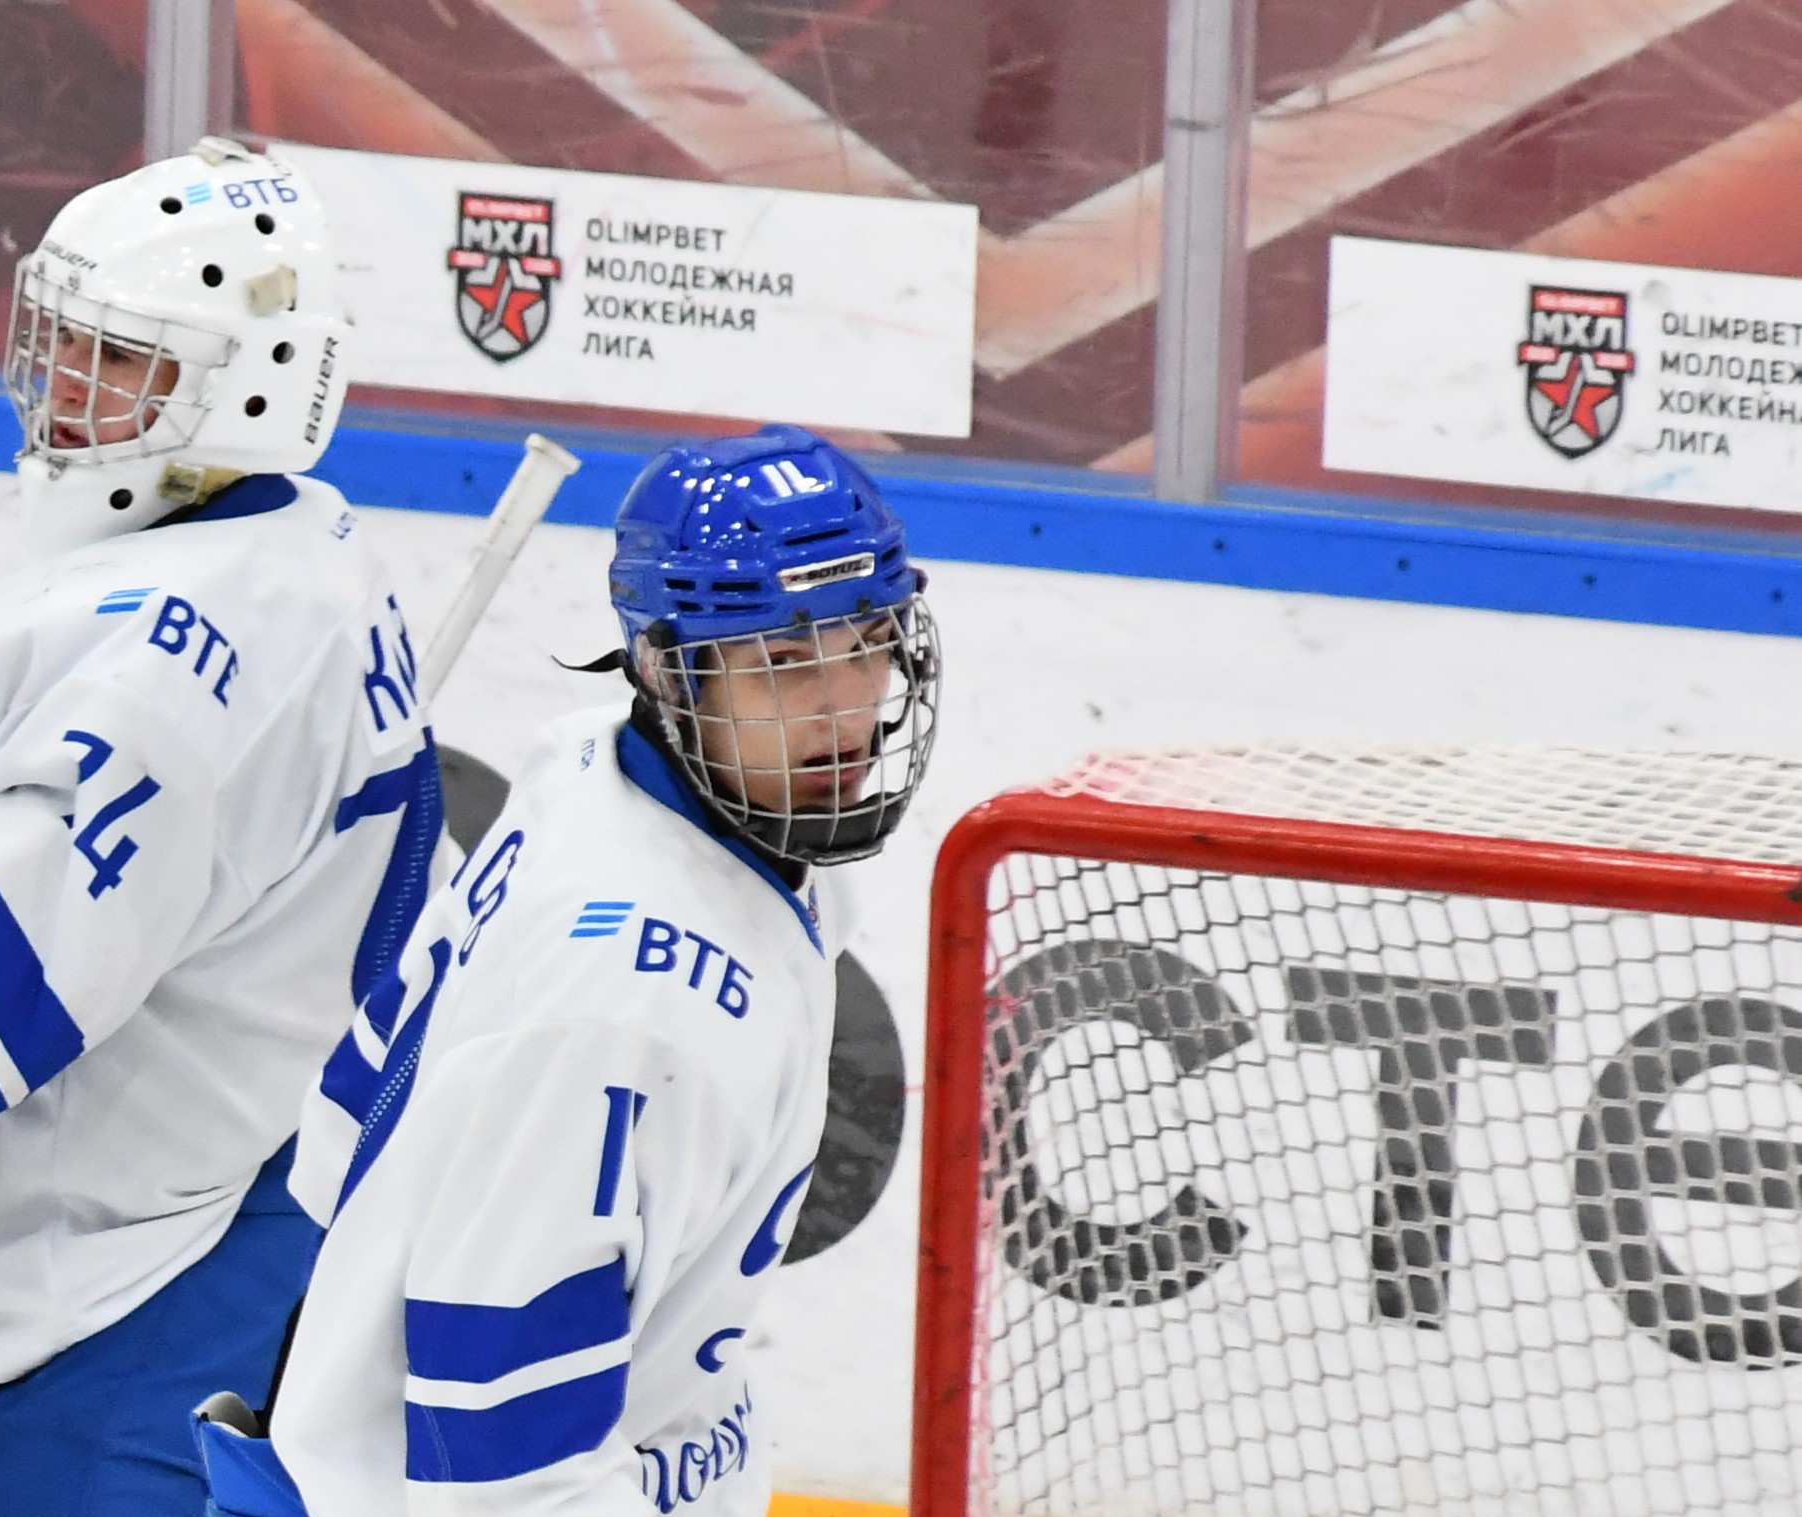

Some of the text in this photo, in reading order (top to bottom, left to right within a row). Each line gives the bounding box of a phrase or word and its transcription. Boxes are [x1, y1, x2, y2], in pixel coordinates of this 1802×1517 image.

[223, 178, 299, 208] ВТБ
[462, 216, 549, 257] МХЛ
[586, 217, 727, 252] OLIMPBET
[584, 255, 794, 298] МОЛОДЕЖНАЯ
[583, 294, 757, 332] ХОККЕЙНАЯ
[1533, 310, 1623, 351] МХЛ
[1661, 311, 1802, 346] OLIMPBET
[583, 332, 654, 361] ЛИГА
[1658, 388, 1802, 424] ХОККЕЙН
[1657, 426, 1731, 456] ЛИГА
[634, 916, 754, 1020] ВТБ
[592, 1084, 649, 1217] 1
